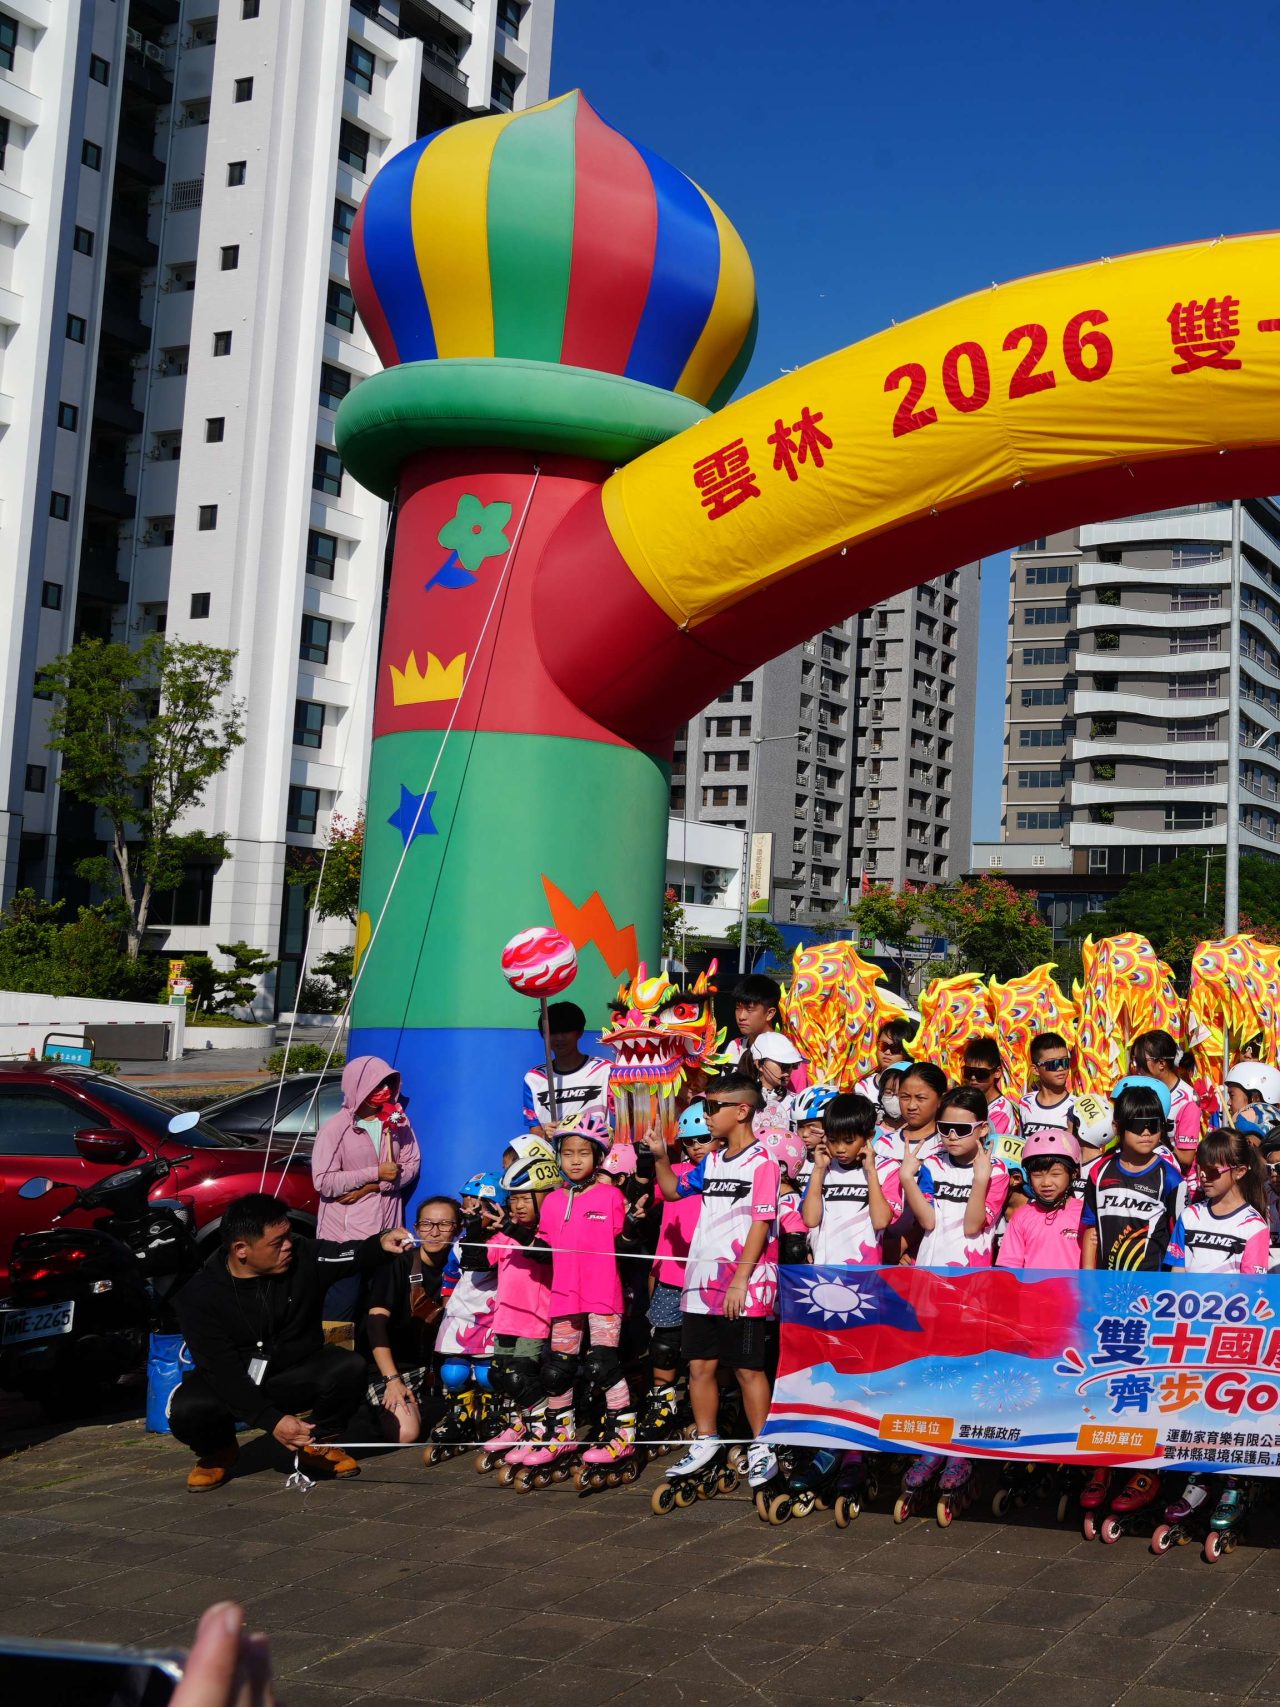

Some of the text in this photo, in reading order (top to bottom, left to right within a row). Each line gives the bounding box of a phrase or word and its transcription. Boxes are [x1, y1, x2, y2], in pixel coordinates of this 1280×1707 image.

[693, 406, 833, 521] 雲林
[883, 309, 1114, 438] 2026
[1080, 1098, 1099, 1119] 004
[1003, 1140, 1024, 1156] 07
[535, 1167, 560, 1181] 030
[824, 1186, 868, 1198] FLAME
[1098, 1195, 1159, 1212] FLAME
[1188, 1233, 1237, 1247] FLAME
[1155, 1292, 1247, 1323] 2026
[891, 1419, 940, 1435] 主辦單位
[959, 1424, 1021, 1442] 雲林縣政府
[1091, 1430, 1143, 1447] 協助單位
